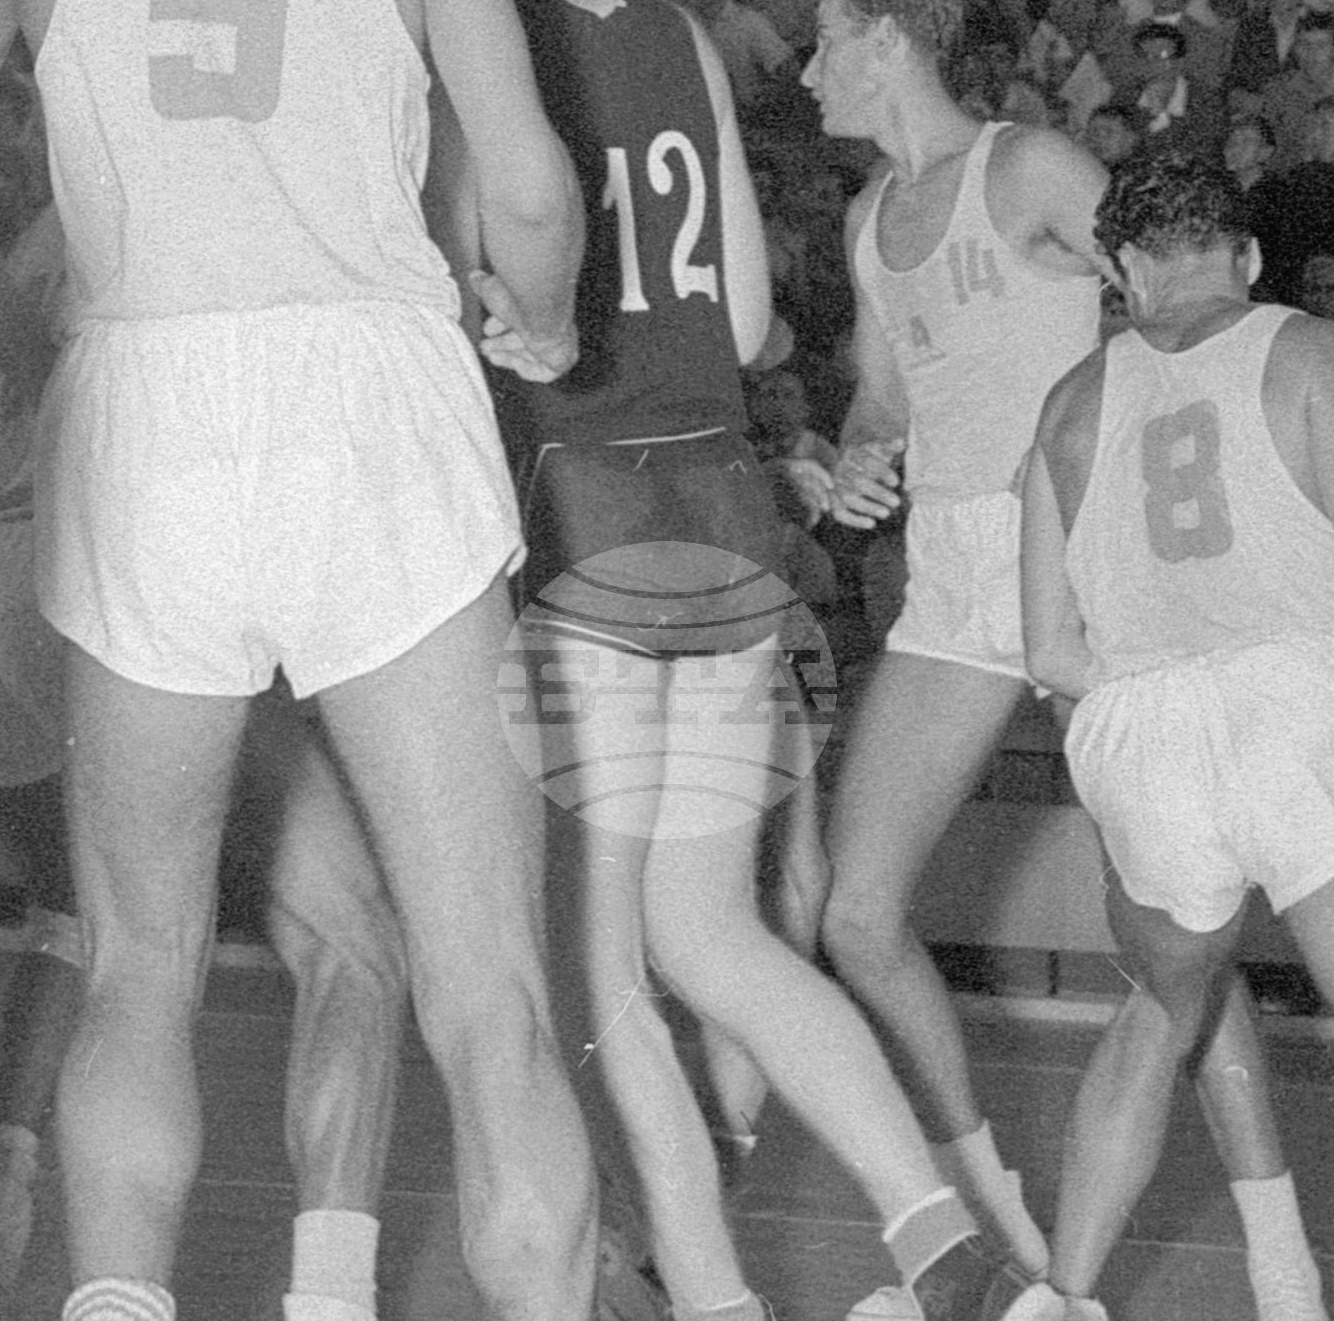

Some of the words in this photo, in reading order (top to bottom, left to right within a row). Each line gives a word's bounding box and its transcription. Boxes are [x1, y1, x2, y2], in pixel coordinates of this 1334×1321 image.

[602, 131, 719, 311] 12
[947, 240, 1006, 306] 14
[1141, 398, 1234, 565] 8
